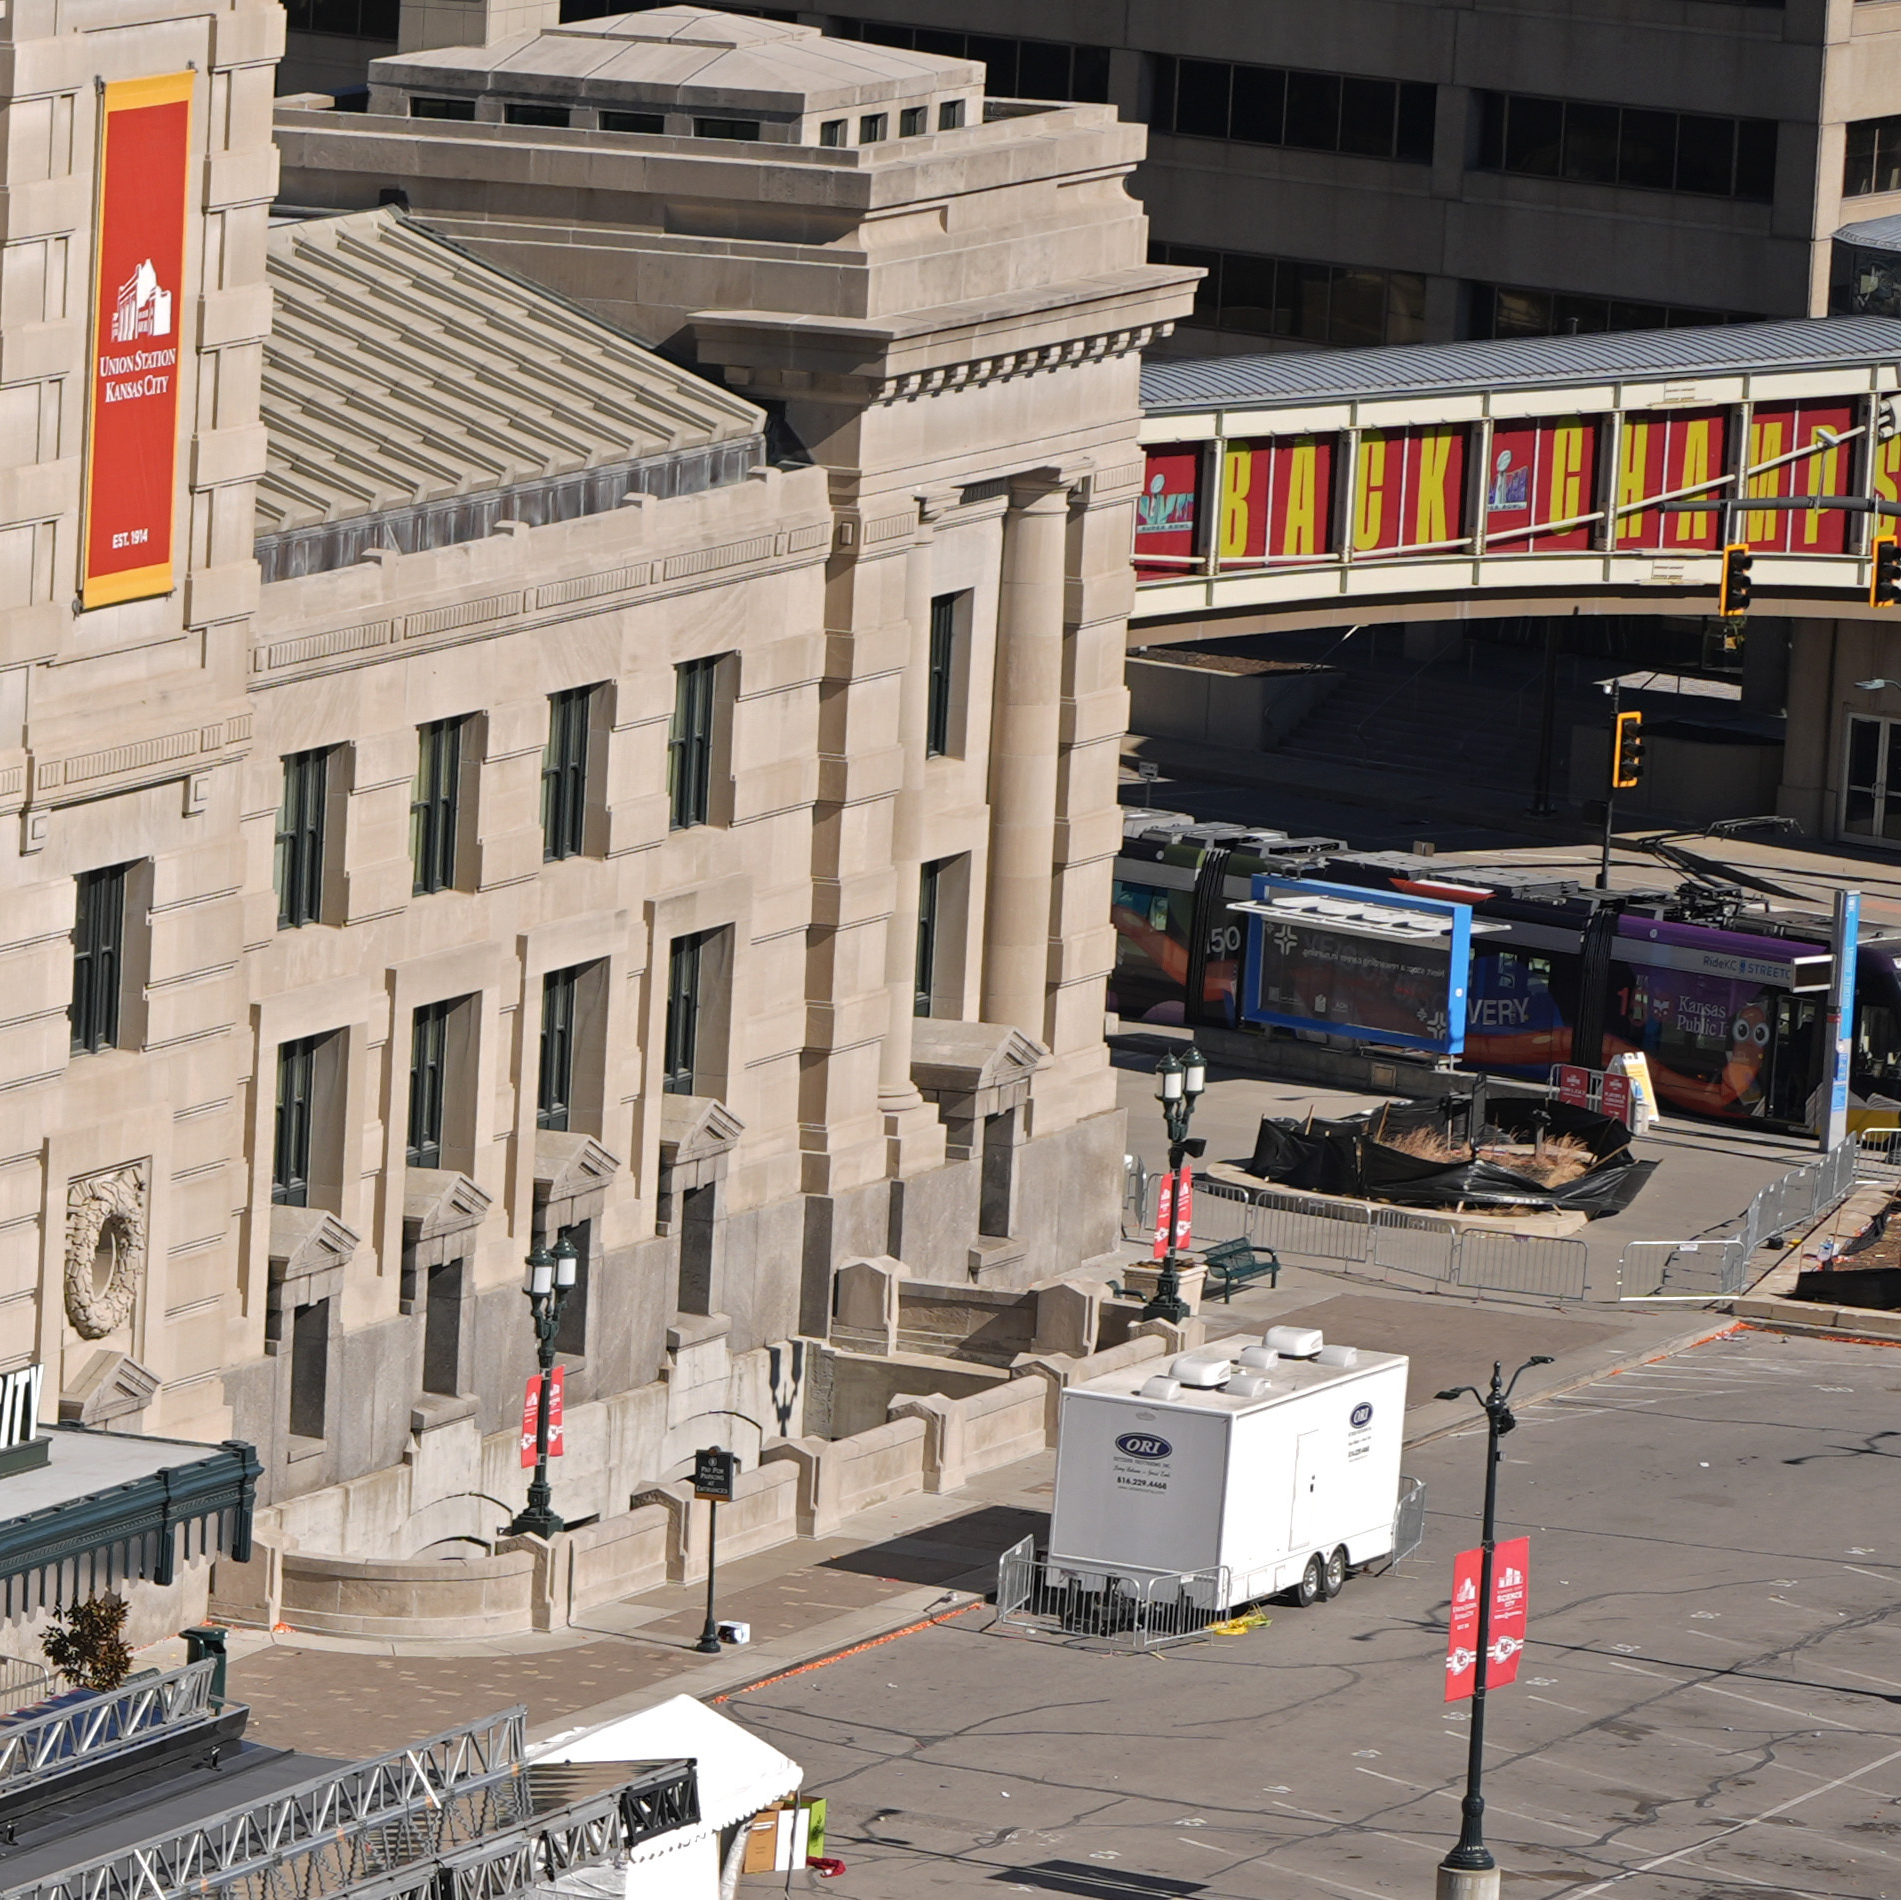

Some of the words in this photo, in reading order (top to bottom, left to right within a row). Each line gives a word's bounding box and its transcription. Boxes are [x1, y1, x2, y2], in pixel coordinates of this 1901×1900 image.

[112, 531, 130, 549] EST.
[130, 528, 148, 545] 1914
[1678, 994, 1727, 1019] Kansas
[1676, 1013, 1721, 1037] Public
[1125, 1438, 1162, 1455] ORI
